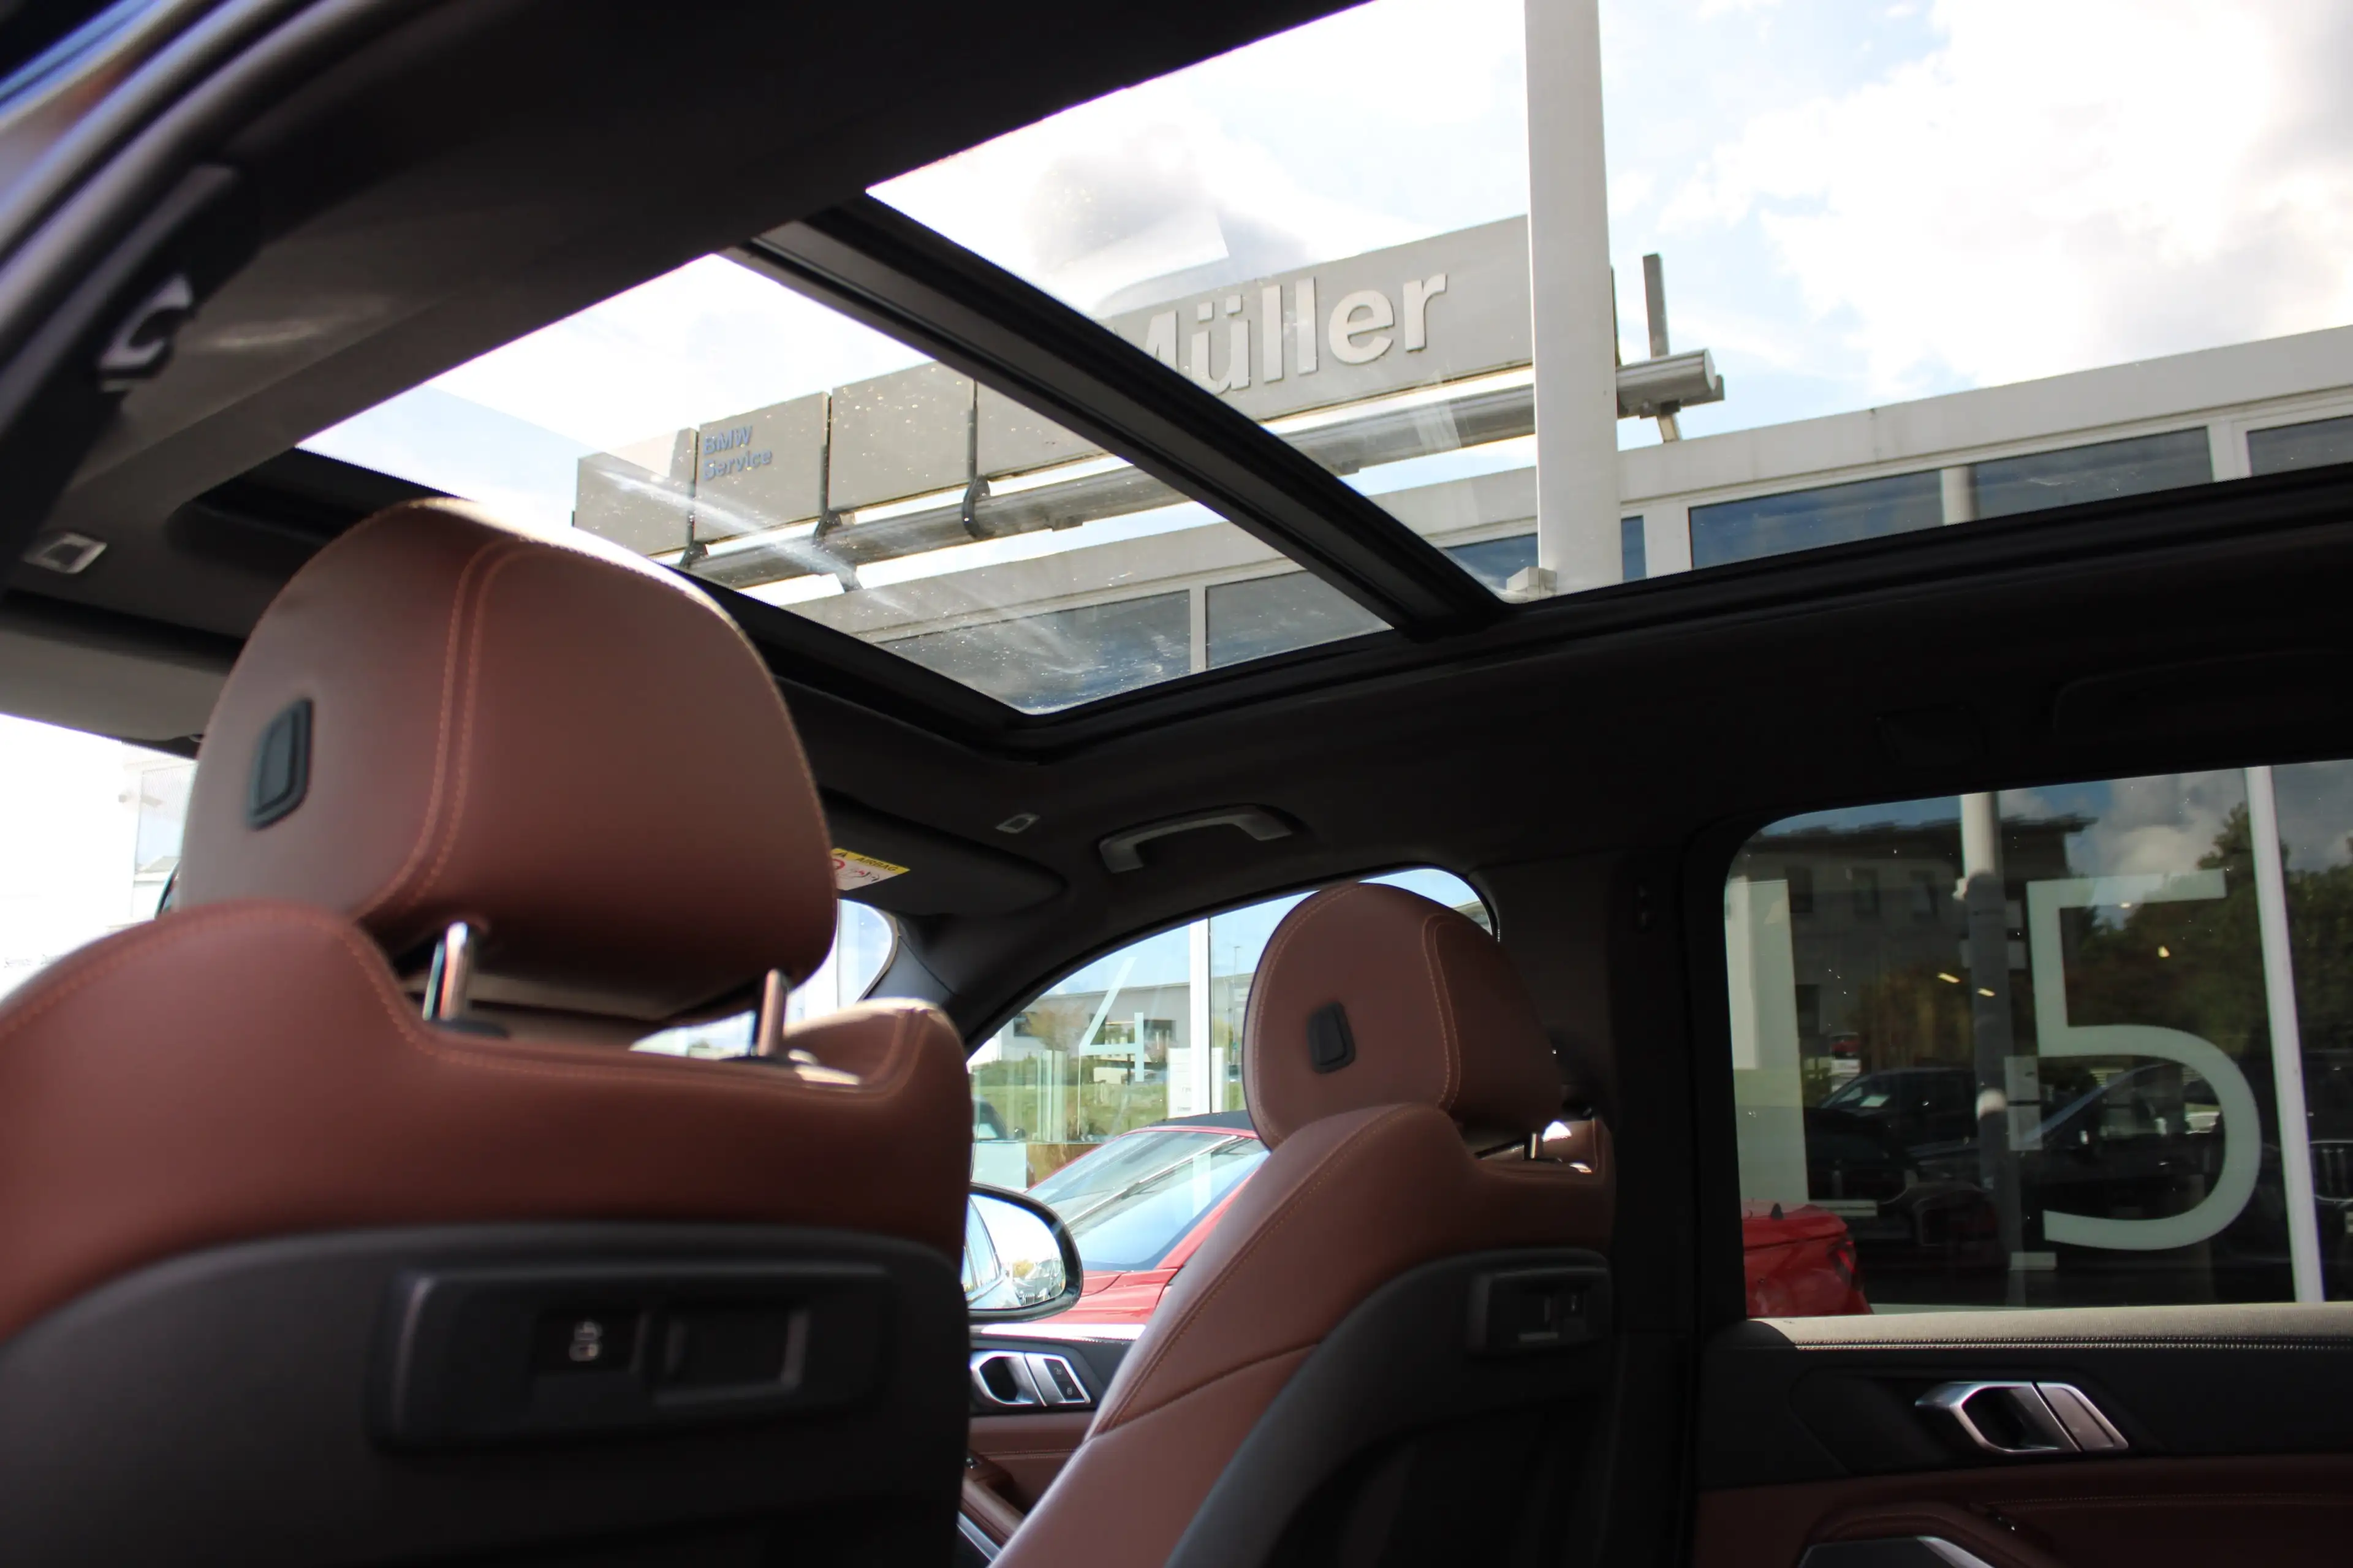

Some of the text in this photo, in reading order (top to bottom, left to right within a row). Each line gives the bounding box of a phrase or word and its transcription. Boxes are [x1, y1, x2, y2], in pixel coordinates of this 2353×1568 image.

[703, 425, 753, 455] BMW
[703, 450, 772, 481] Service
[855, 857, 898, 871] AIRBAG
[1078, 956, 1145, 1082] 4
[2026, 870, 2262, 1251] 5
